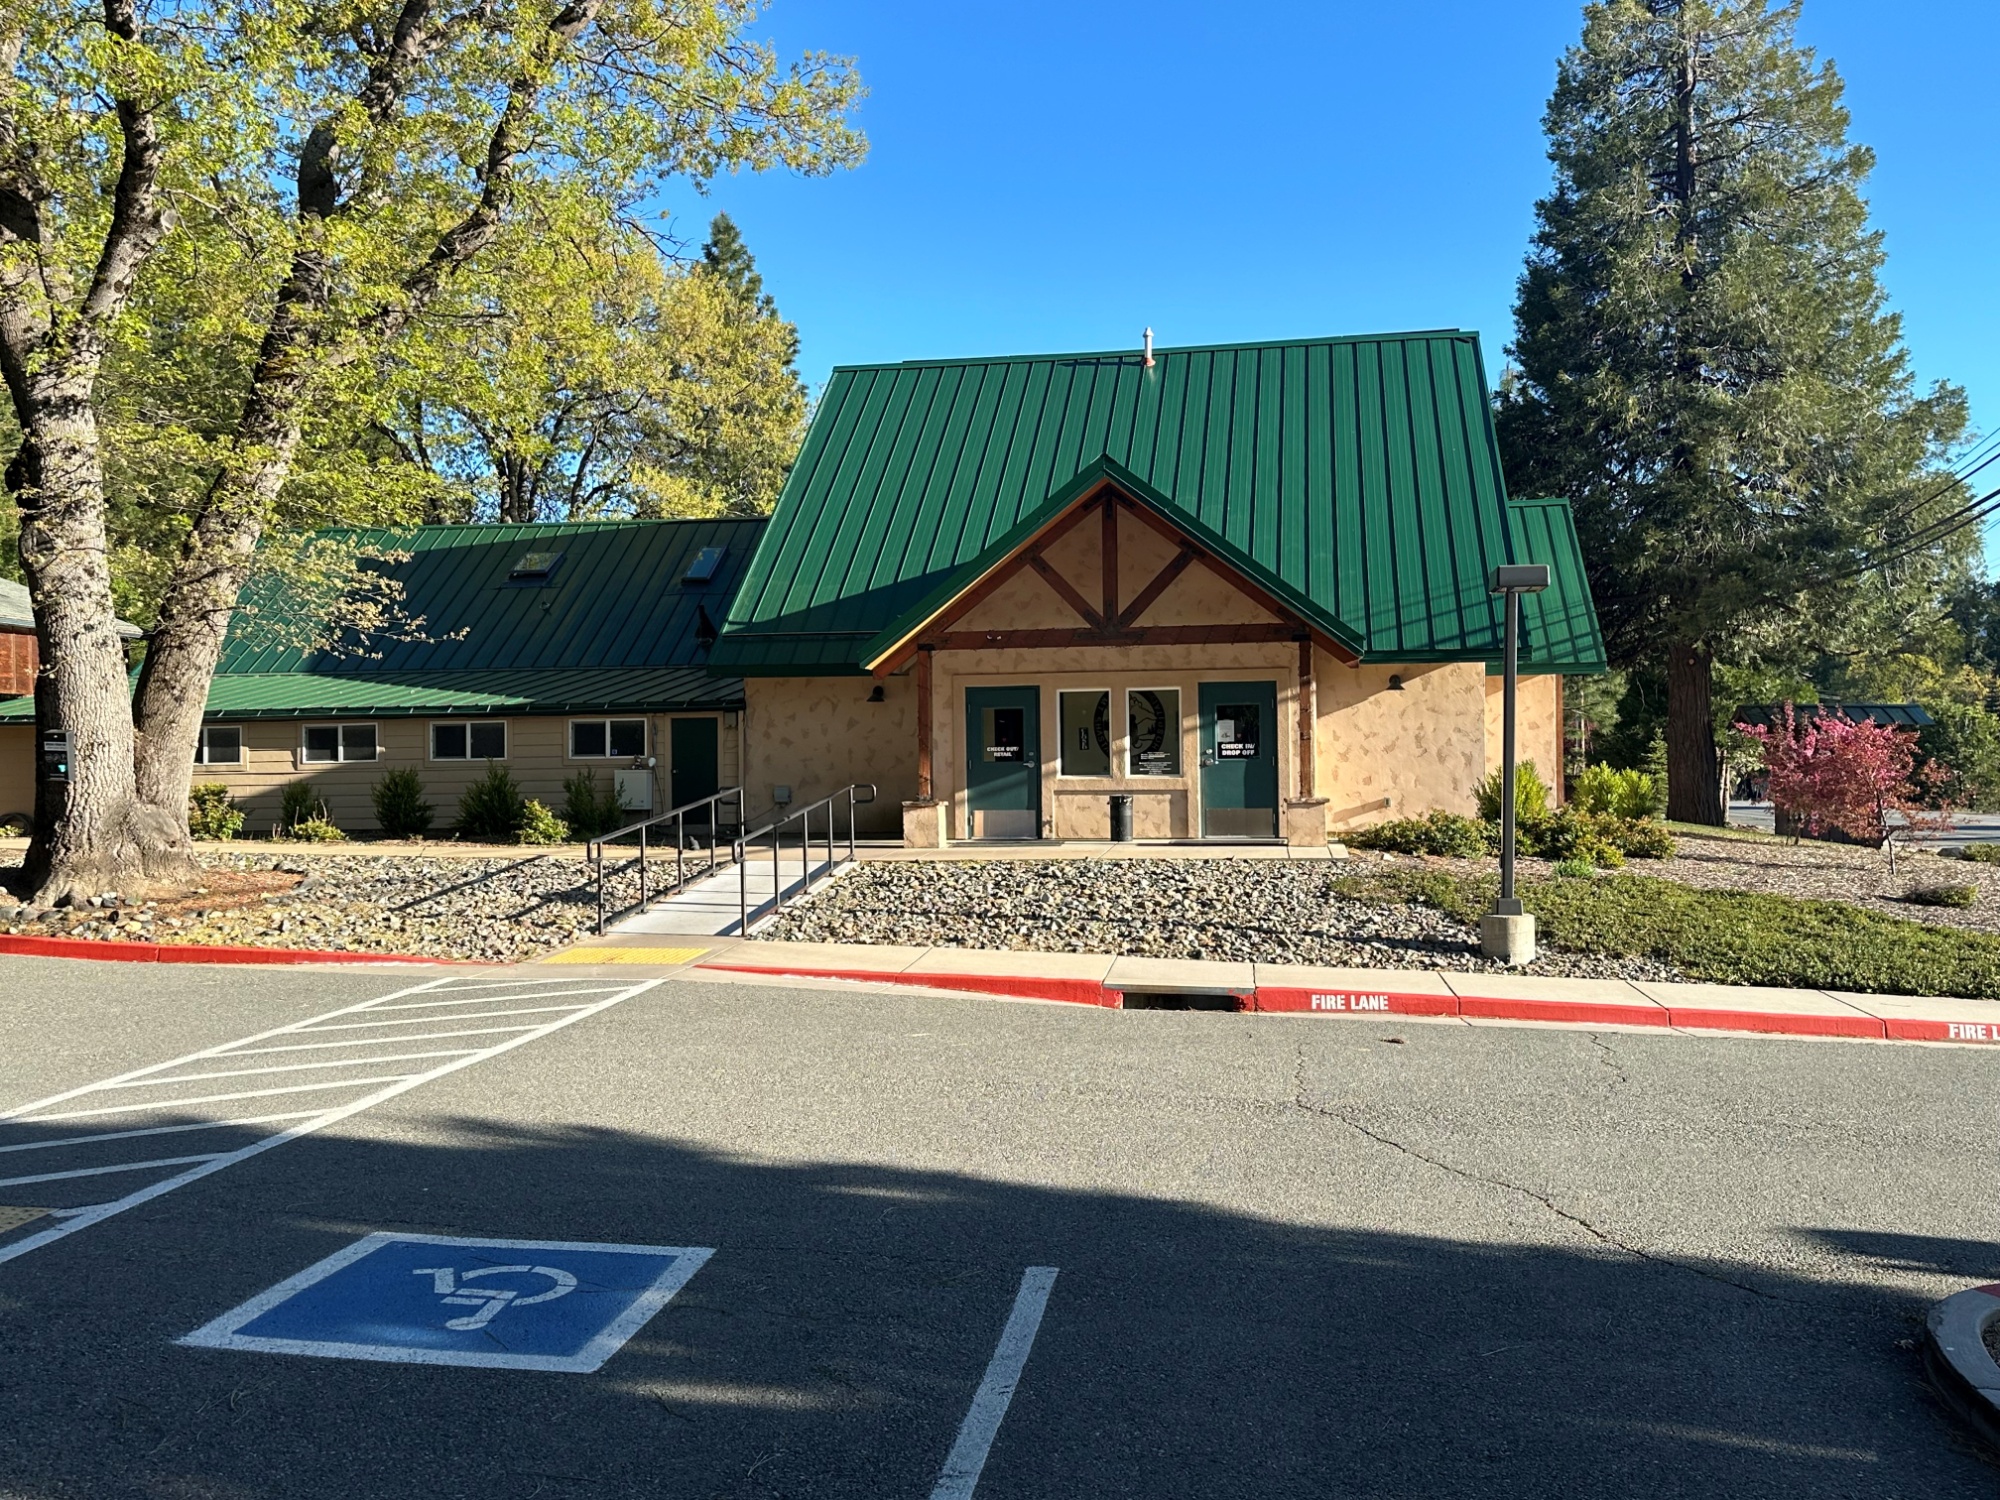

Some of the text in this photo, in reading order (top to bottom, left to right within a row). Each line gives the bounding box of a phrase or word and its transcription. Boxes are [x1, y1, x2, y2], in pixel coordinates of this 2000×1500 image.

[1311, 994, 1389, 1010] FIRE LANE
[1948, 1023, 1987, 1040] FIRE
